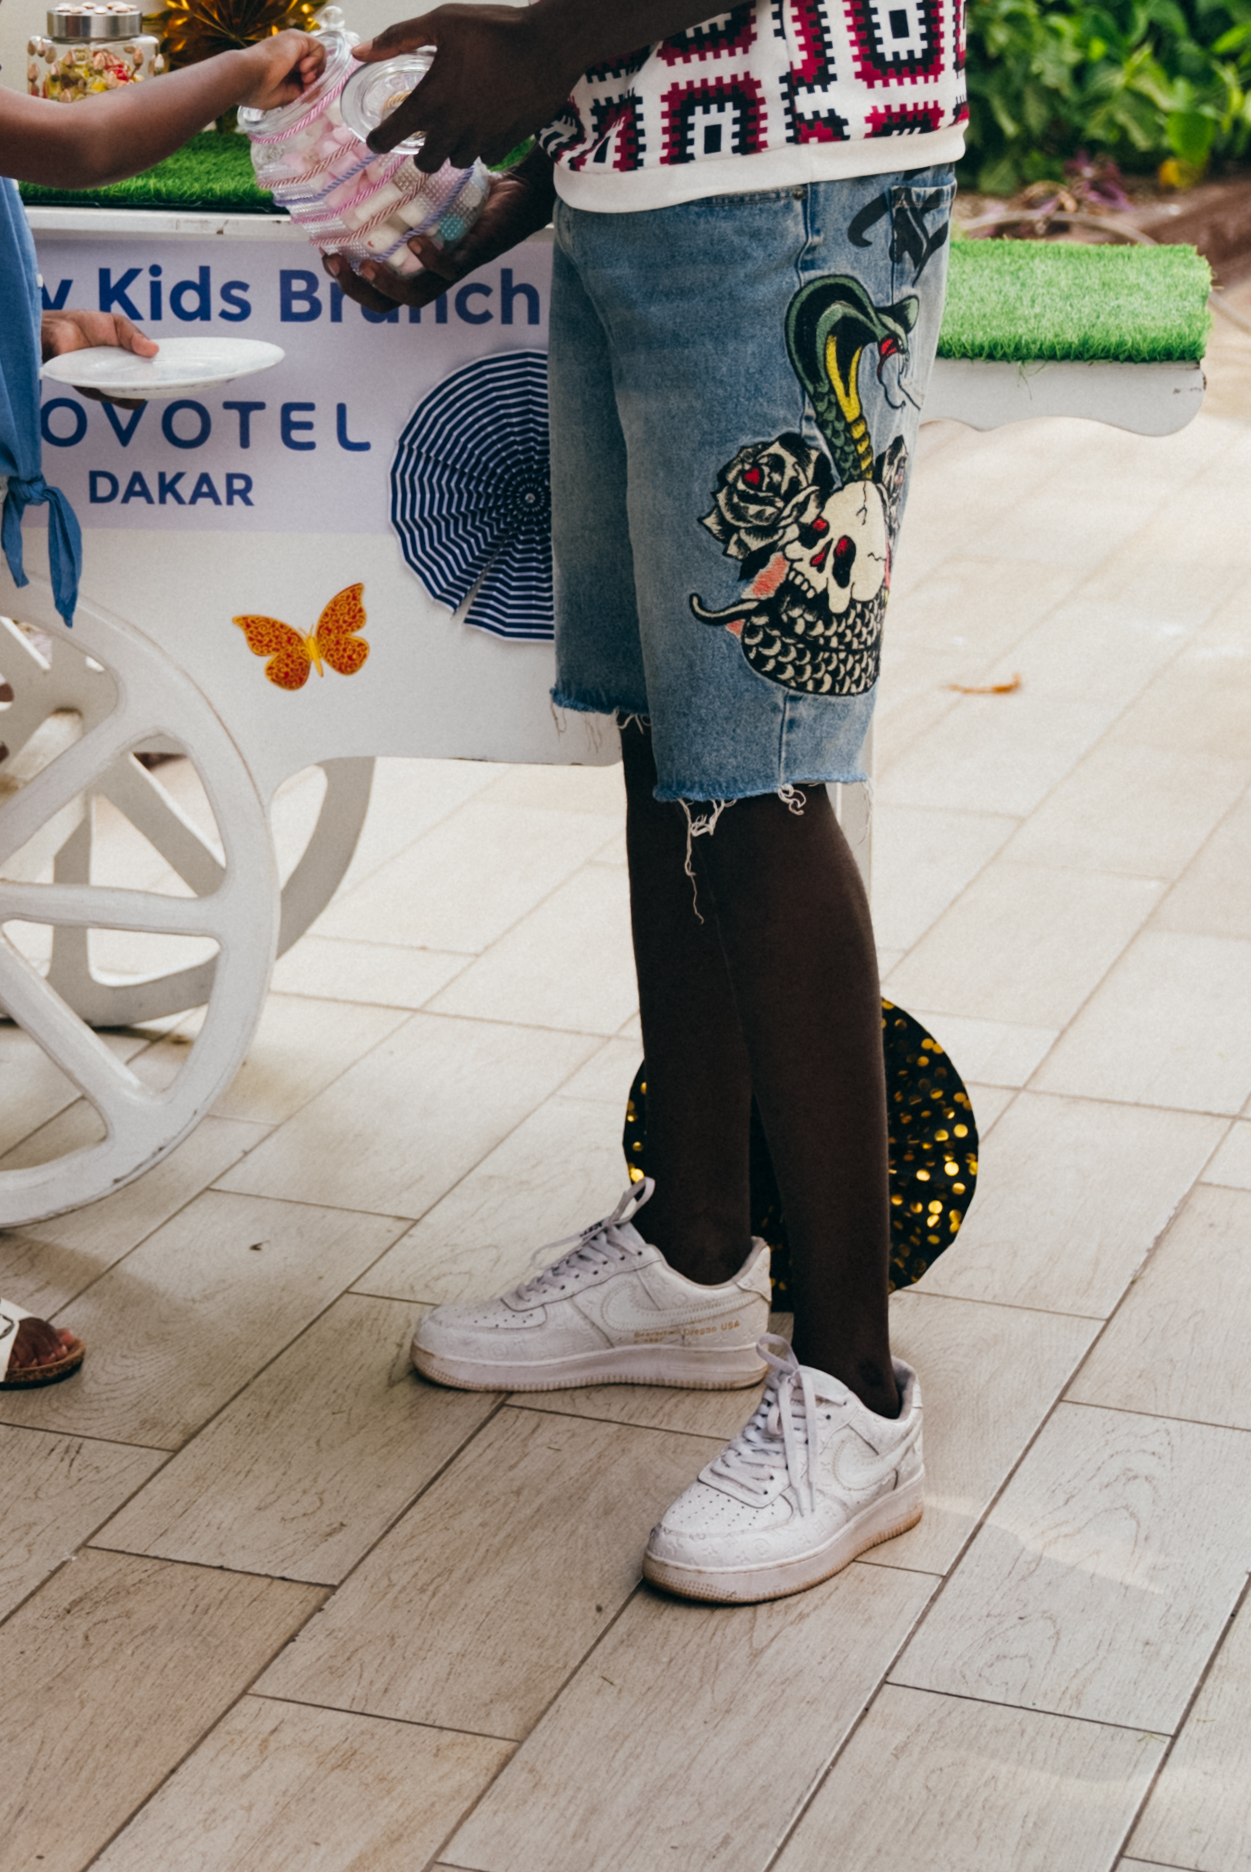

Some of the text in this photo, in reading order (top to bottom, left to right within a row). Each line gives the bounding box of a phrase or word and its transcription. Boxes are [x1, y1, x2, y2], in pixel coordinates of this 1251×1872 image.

[98, 264, 252, 323] Kids
[40, 397, 372, 453] OVOTEL
[89, 469, 254, 507] DAKAR
[721, 1319, 741, 1331] USA
